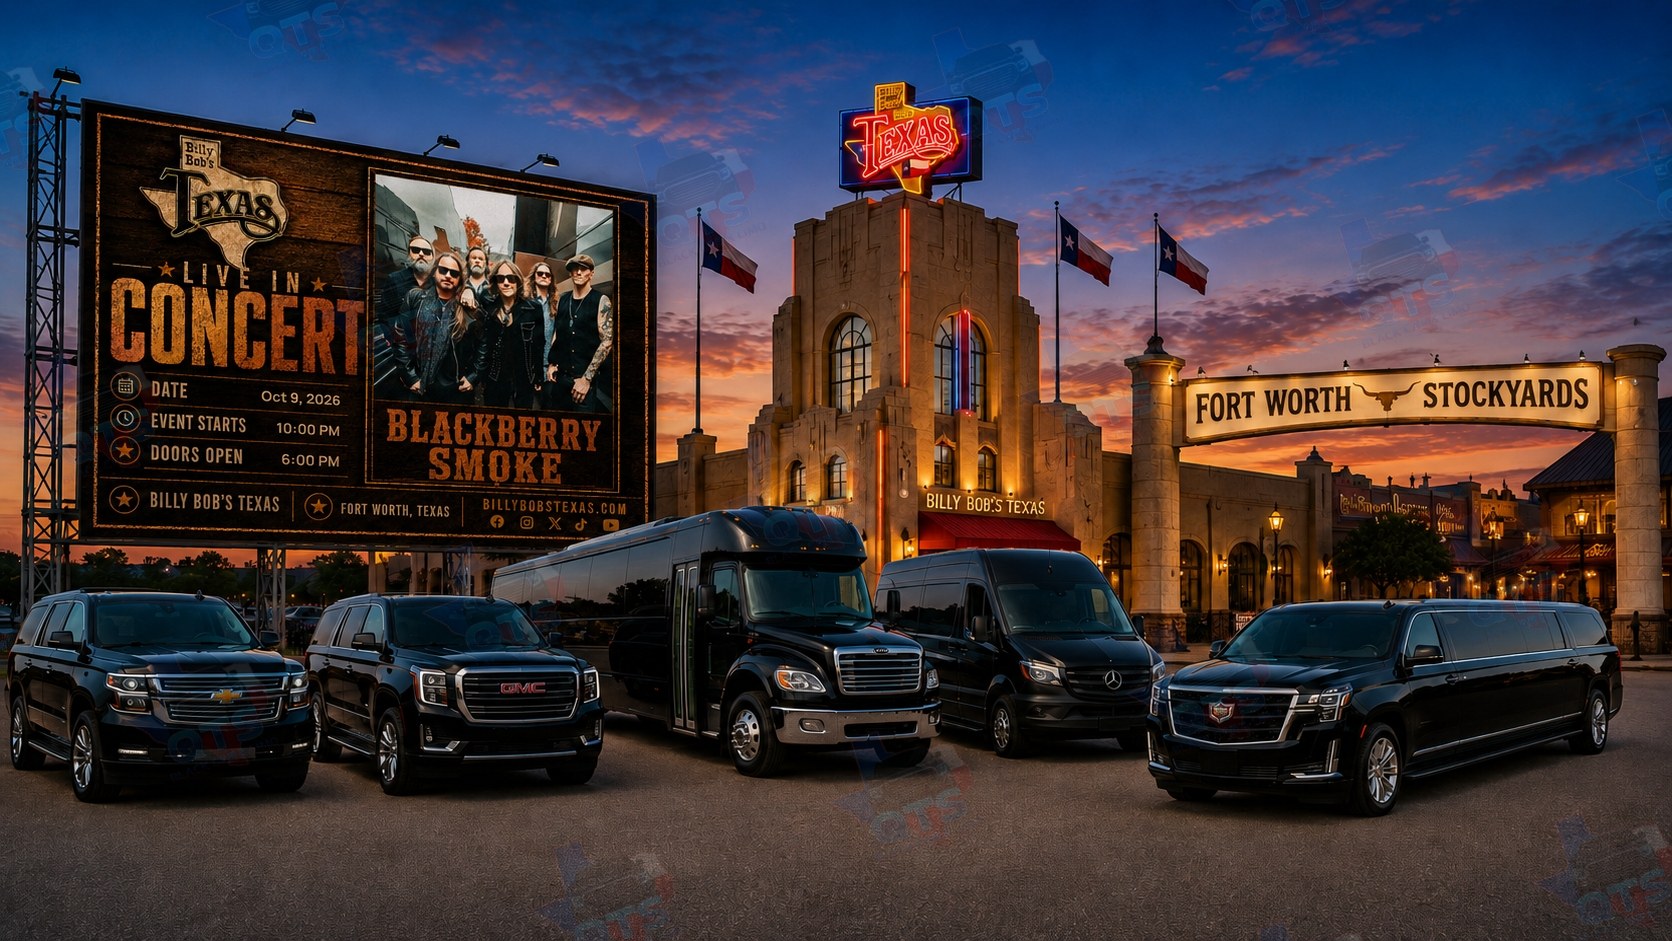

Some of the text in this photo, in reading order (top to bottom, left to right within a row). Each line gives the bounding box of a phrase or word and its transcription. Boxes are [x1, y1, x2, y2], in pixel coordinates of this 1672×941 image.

[185, 142, 214, 158] Billy
[185, 154, 214, 169] Bob's
[184, 261, 299, 293] LIVE IN
[111, 277, 365, 375] CONCERT
[152, 381, 188, 399] DATE
[261, 390, 341, 406] Oct 9, 2026
[1195, 378, 1589, 425] FORT WORTH STOCKYARDS
[151, 412, 247, 433] EVENT STARTS
[276, 422, 340, 437] 10:00 PM
[387, 408, 602, 451] BLACKBERRY
[151, 445, 243, 465] DOORS OPEN
[281, 453, 340, 467] 6:00 PM
[428, 447, 562, 485] SMOKE
[150, 491, 280, 512] BILLY BOB'S TEXAS
[340, 502, 451, 518] FORT WORTH, TEXAS
[483, 498, 627, 516] BILLYBOBSTEXAS.COM
[926, 492, 961, 510] BILLY
[1006, 499, 1045, 514] TEXAS
[500, 681, 546, 695] GMC
